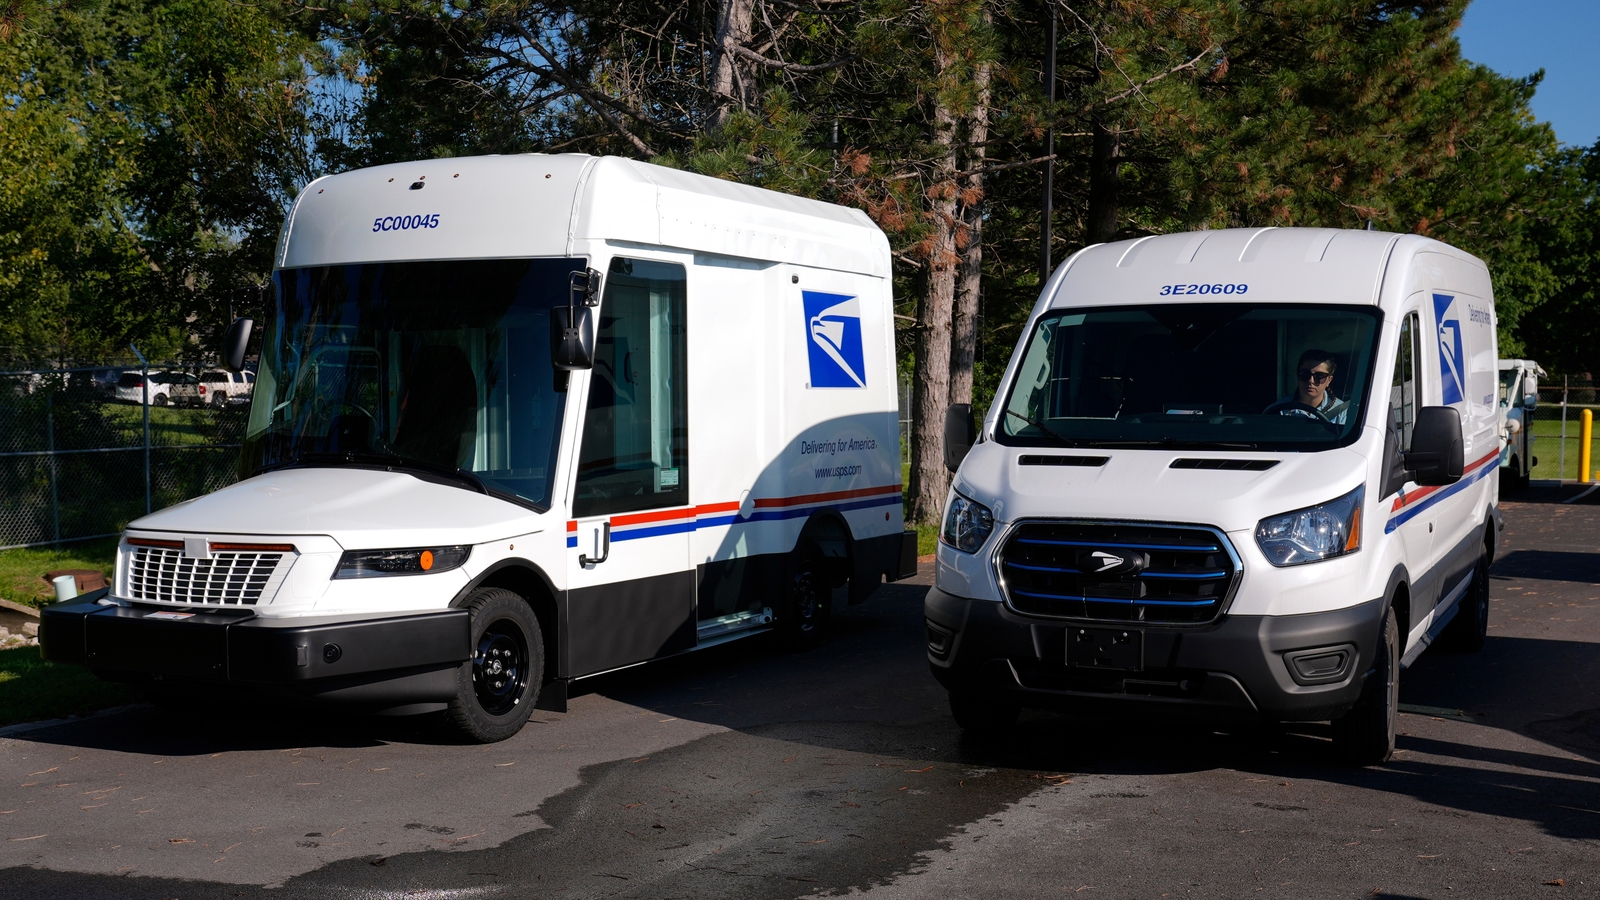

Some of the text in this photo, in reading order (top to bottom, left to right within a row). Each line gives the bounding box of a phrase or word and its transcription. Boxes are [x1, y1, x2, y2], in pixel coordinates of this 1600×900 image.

[372, 214, 440, 232] 5C00045
[1159, 283, 1248, 296] 3E20609
[801, 439, 836, 456] Delivering
[837, 438, 848, 452] for
[815, 465, 862, 479] www.usps.com
